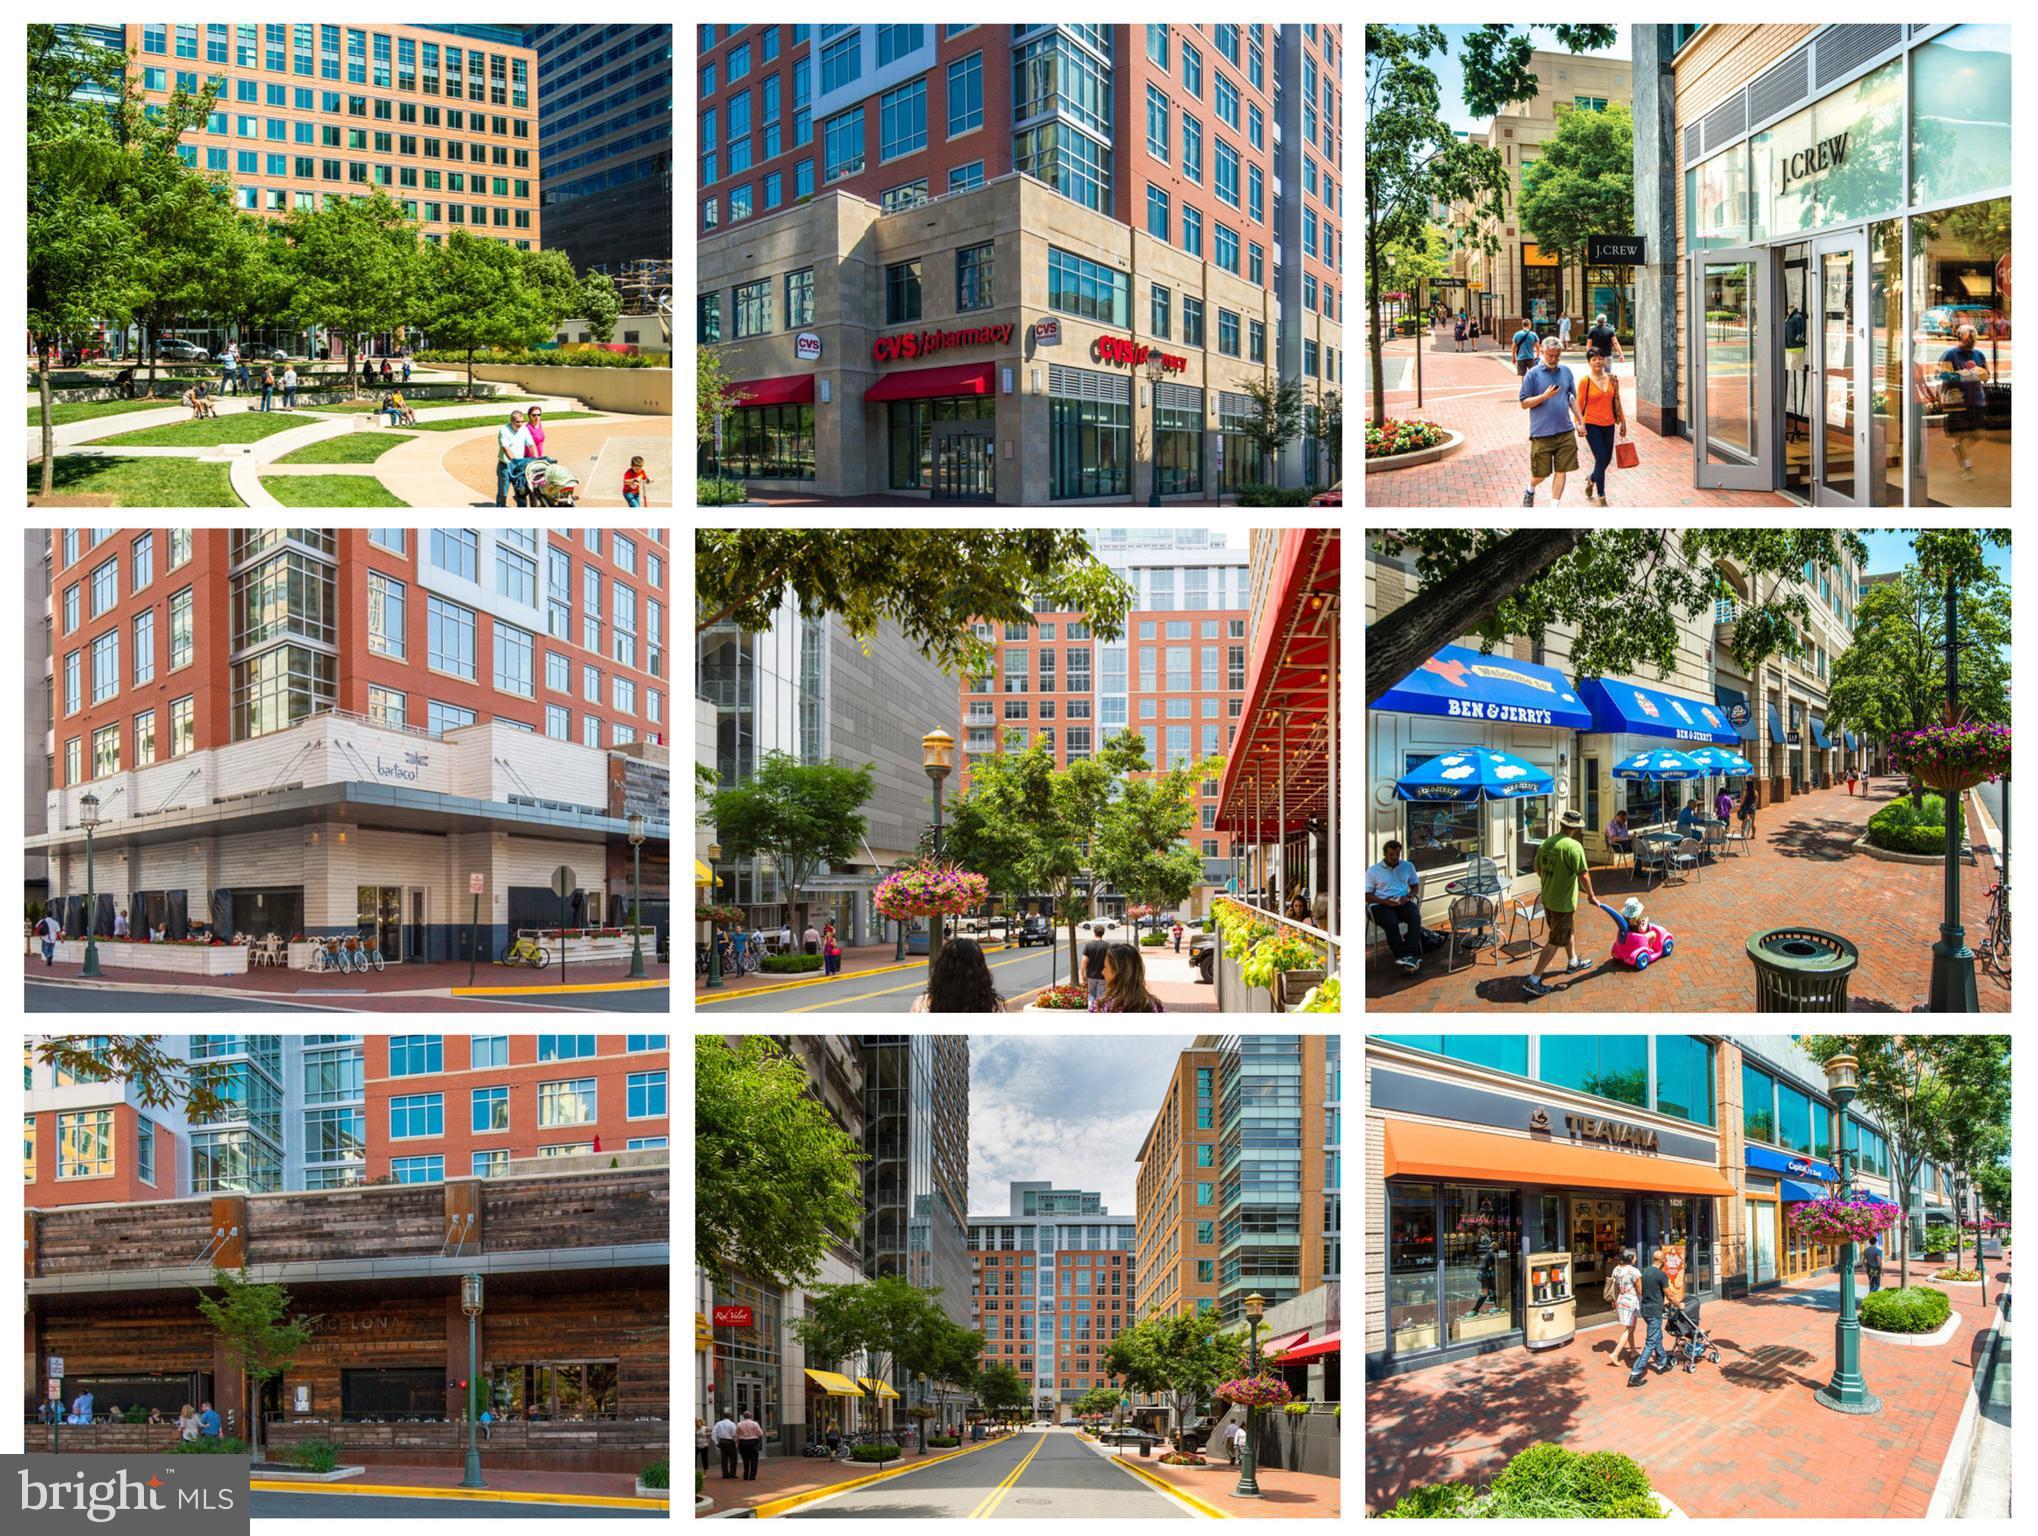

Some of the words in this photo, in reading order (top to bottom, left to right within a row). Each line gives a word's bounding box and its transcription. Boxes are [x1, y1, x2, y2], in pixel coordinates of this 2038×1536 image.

[1781, 132, 1848, 196] J.CREW
[1595, 245, 1637, 259] J.CREW
[1036, 323, 1057, 335] CVS
[799, 338, 820, 350] CVS
[873, 322, 1015, 362] CVS/pharmacy
[1448, 699, 1484, 718] BEN
[1486, 704, 1500, 719] &
[1500, 705, 1552, 725] JERRY'S
[1676, 729, 1689, 739] BEN
[377, 756, 415, 781] bartaco
[1566, 1113, 1659, 1149] TEAVANA
[715, 1309, 732, 1321] Red
[730, 1309, 748, 1320] Velvet
